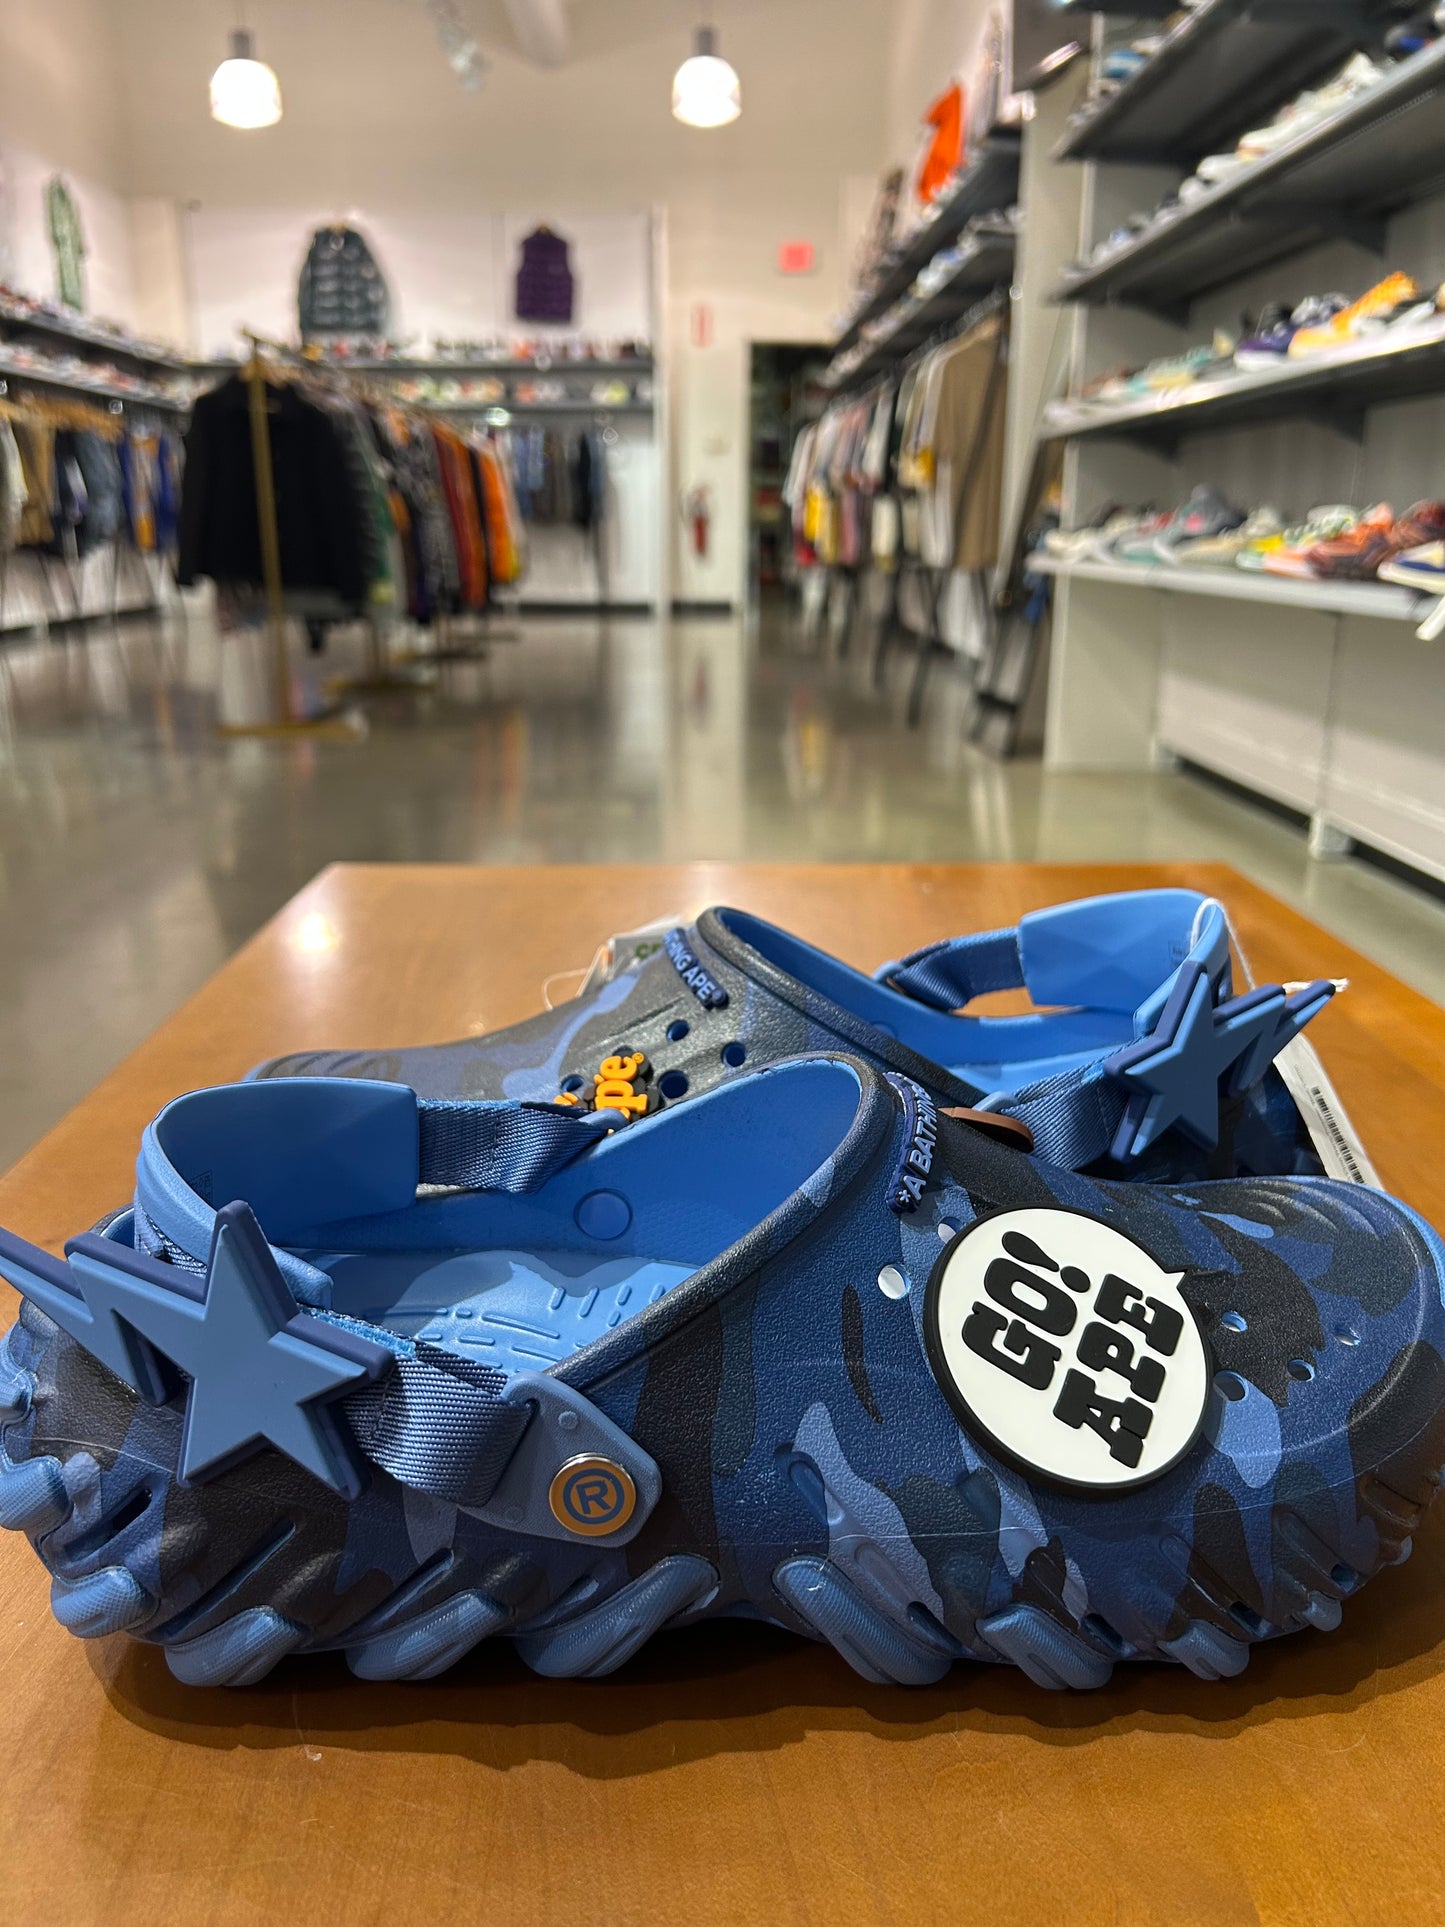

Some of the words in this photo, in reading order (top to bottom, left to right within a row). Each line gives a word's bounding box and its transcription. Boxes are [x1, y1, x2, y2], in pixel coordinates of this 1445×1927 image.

[682, 966, 716, 1000] APE
[961, 1230, 1091, 1391] GO!
[1052, 1272, 1185, 1469] APE
